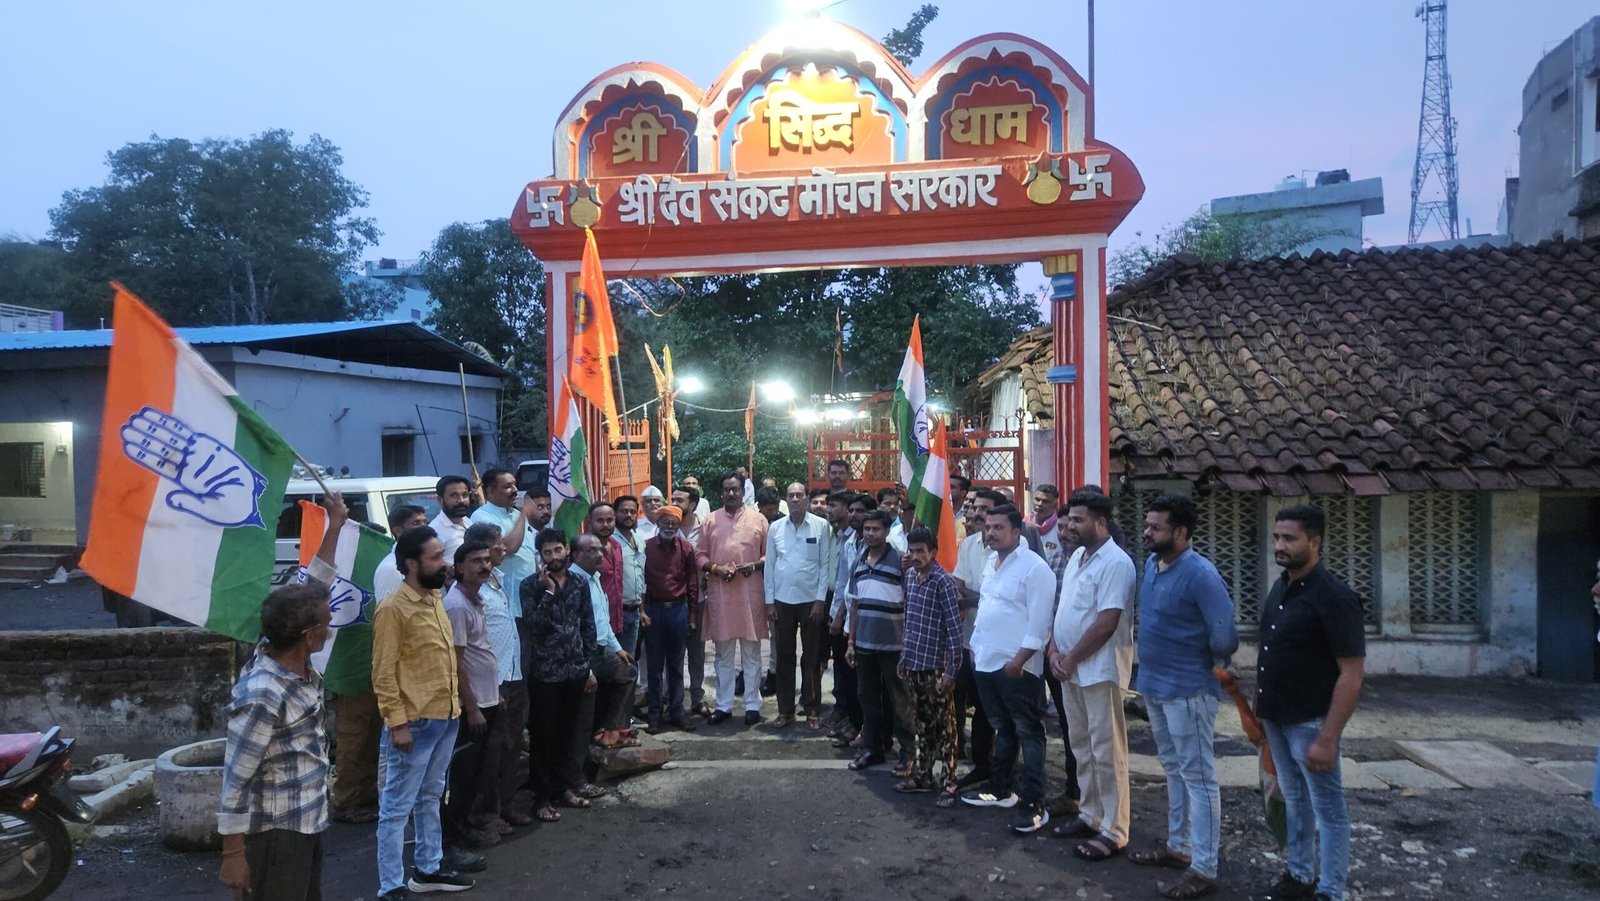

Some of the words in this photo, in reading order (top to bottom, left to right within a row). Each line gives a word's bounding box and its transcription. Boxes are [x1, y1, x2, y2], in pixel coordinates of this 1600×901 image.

[613, 112, 667, 165] श्री
[950, 103, 1033, 145] धाम
[618, 174, 657, 225] श्री
[659, 176, 706, 226] देव
[797, 167, 886, 215] मोचन
[890, 165, 1002, 212] सरकार
